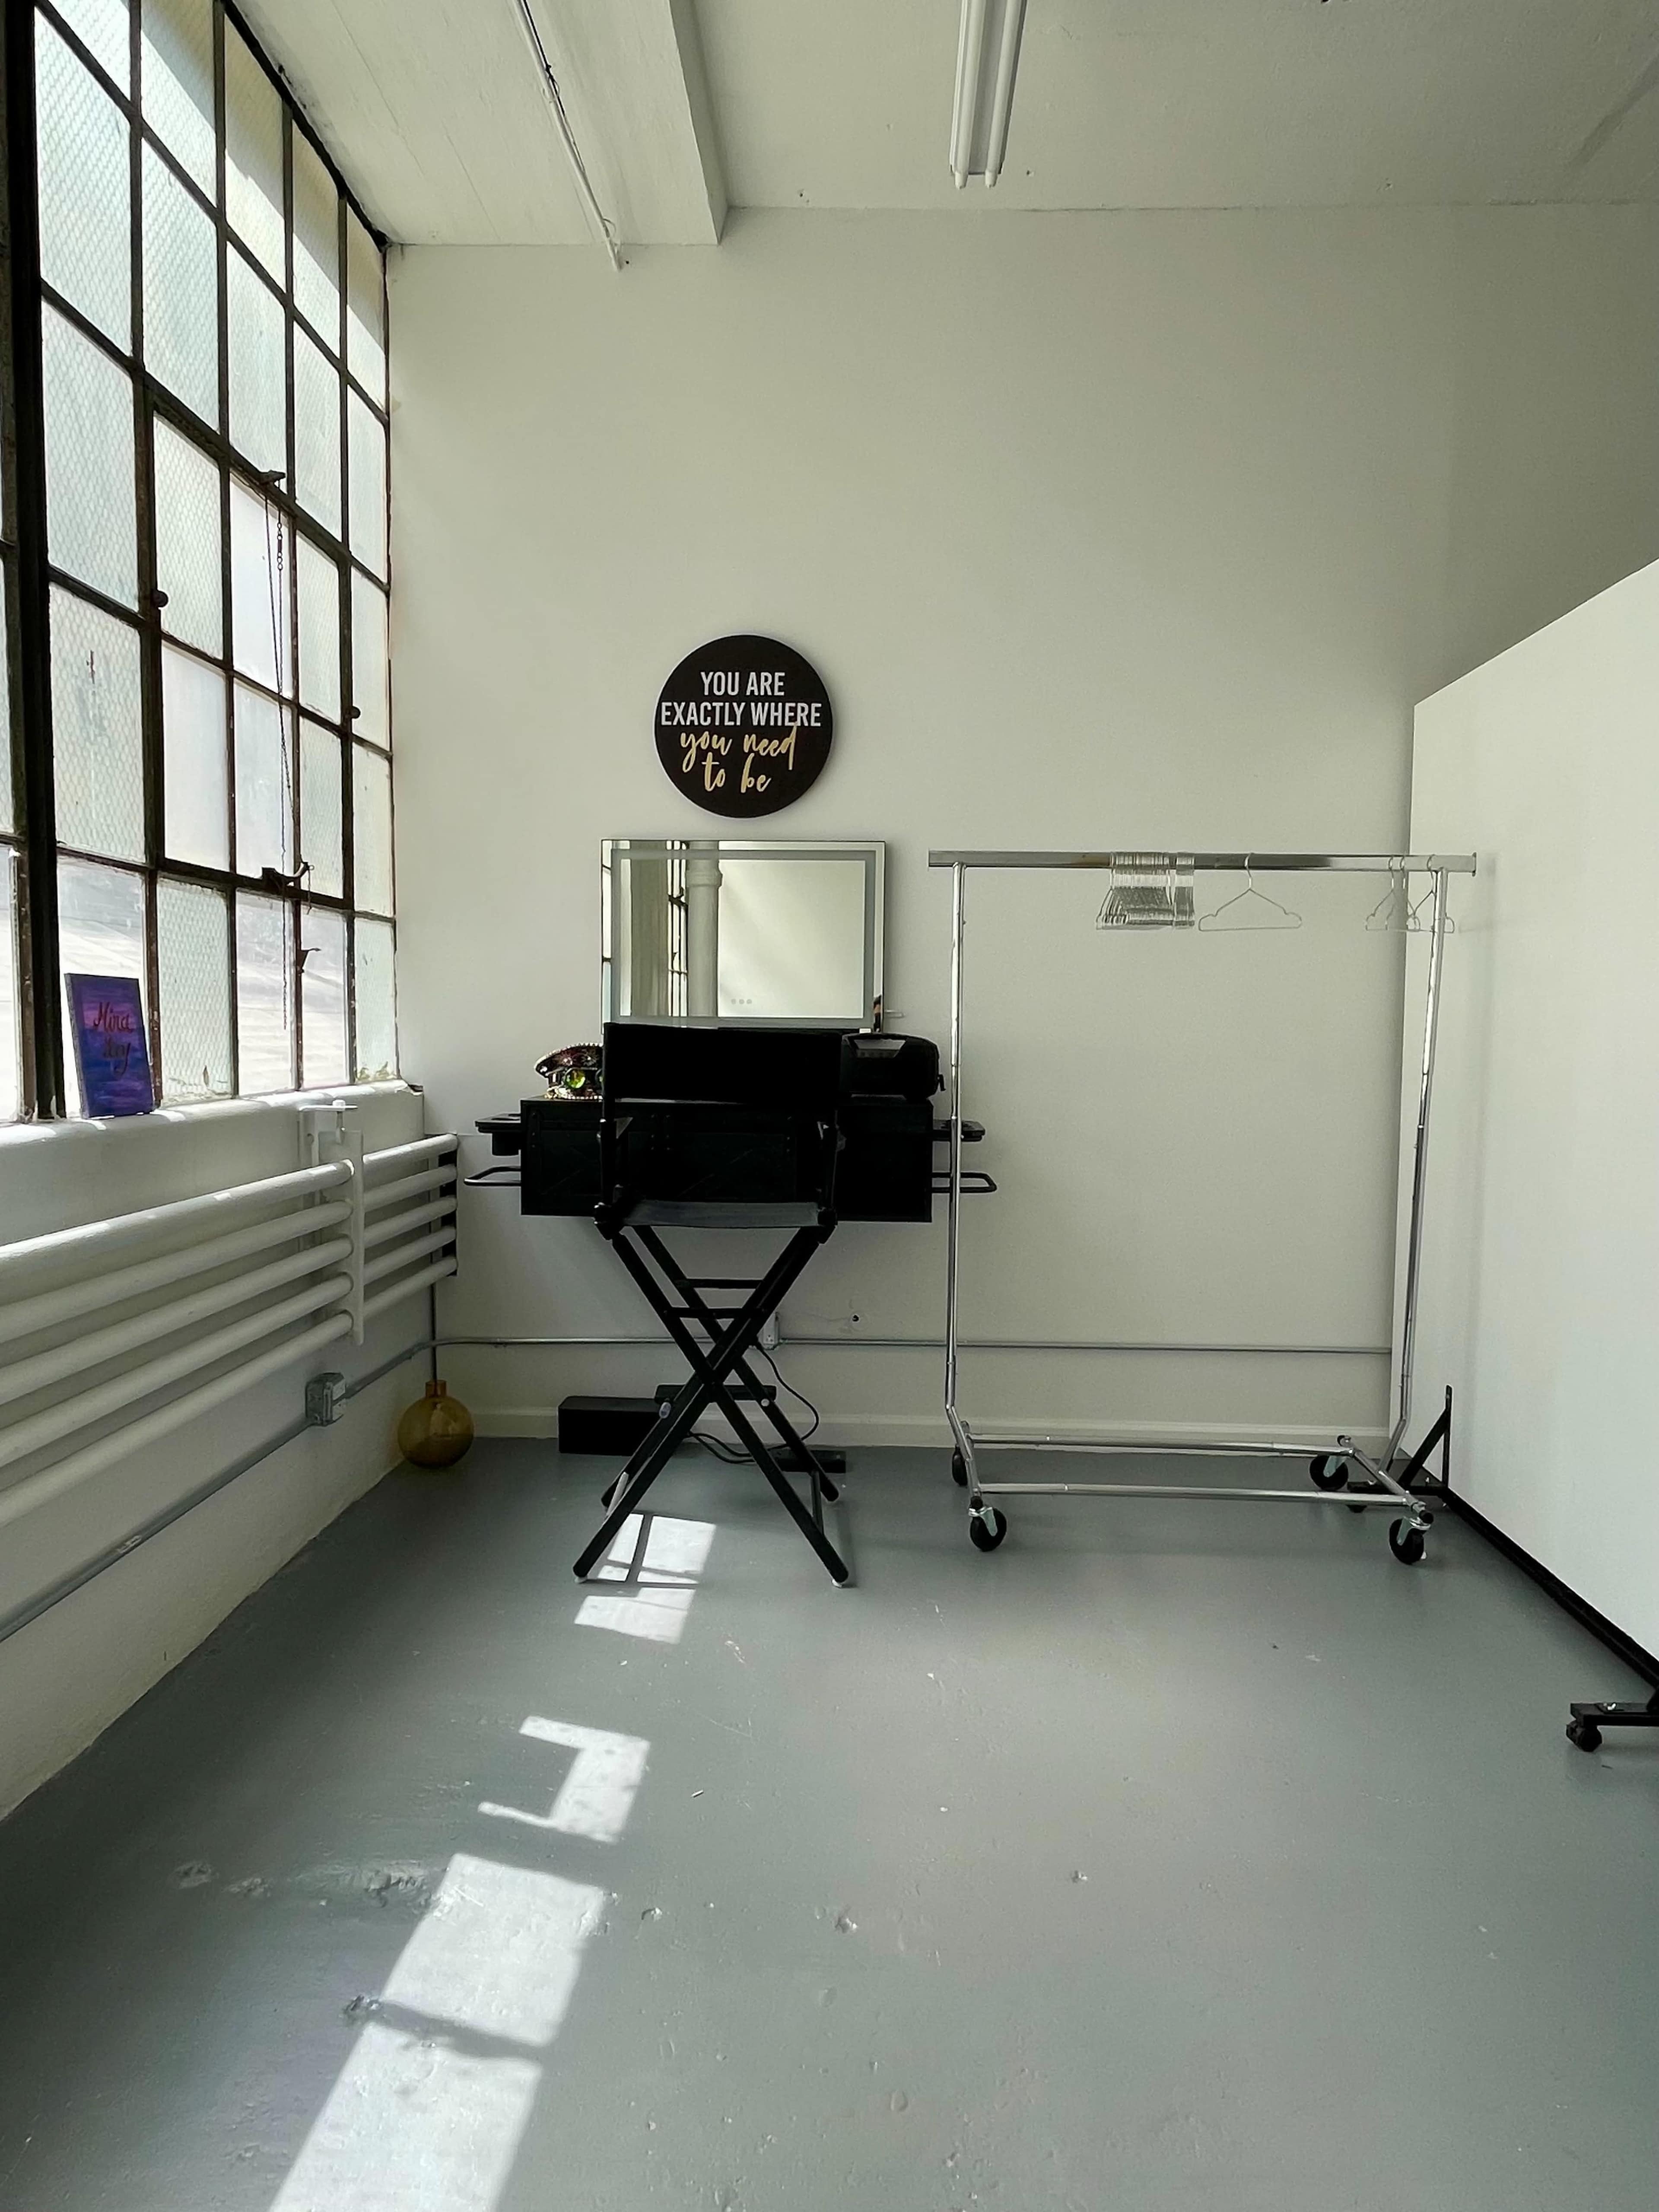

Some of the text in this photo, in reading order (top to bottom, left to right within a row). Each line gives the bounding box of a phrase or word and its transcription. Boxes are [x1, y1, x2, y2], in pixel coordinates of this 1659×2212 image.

[700, 671, 785, 696] YOU ARE
[661, 702, 822, 727] EXACTLY WHERE
[680, 721, 798, 773] you need
[701, 752, 772, 793] to be
